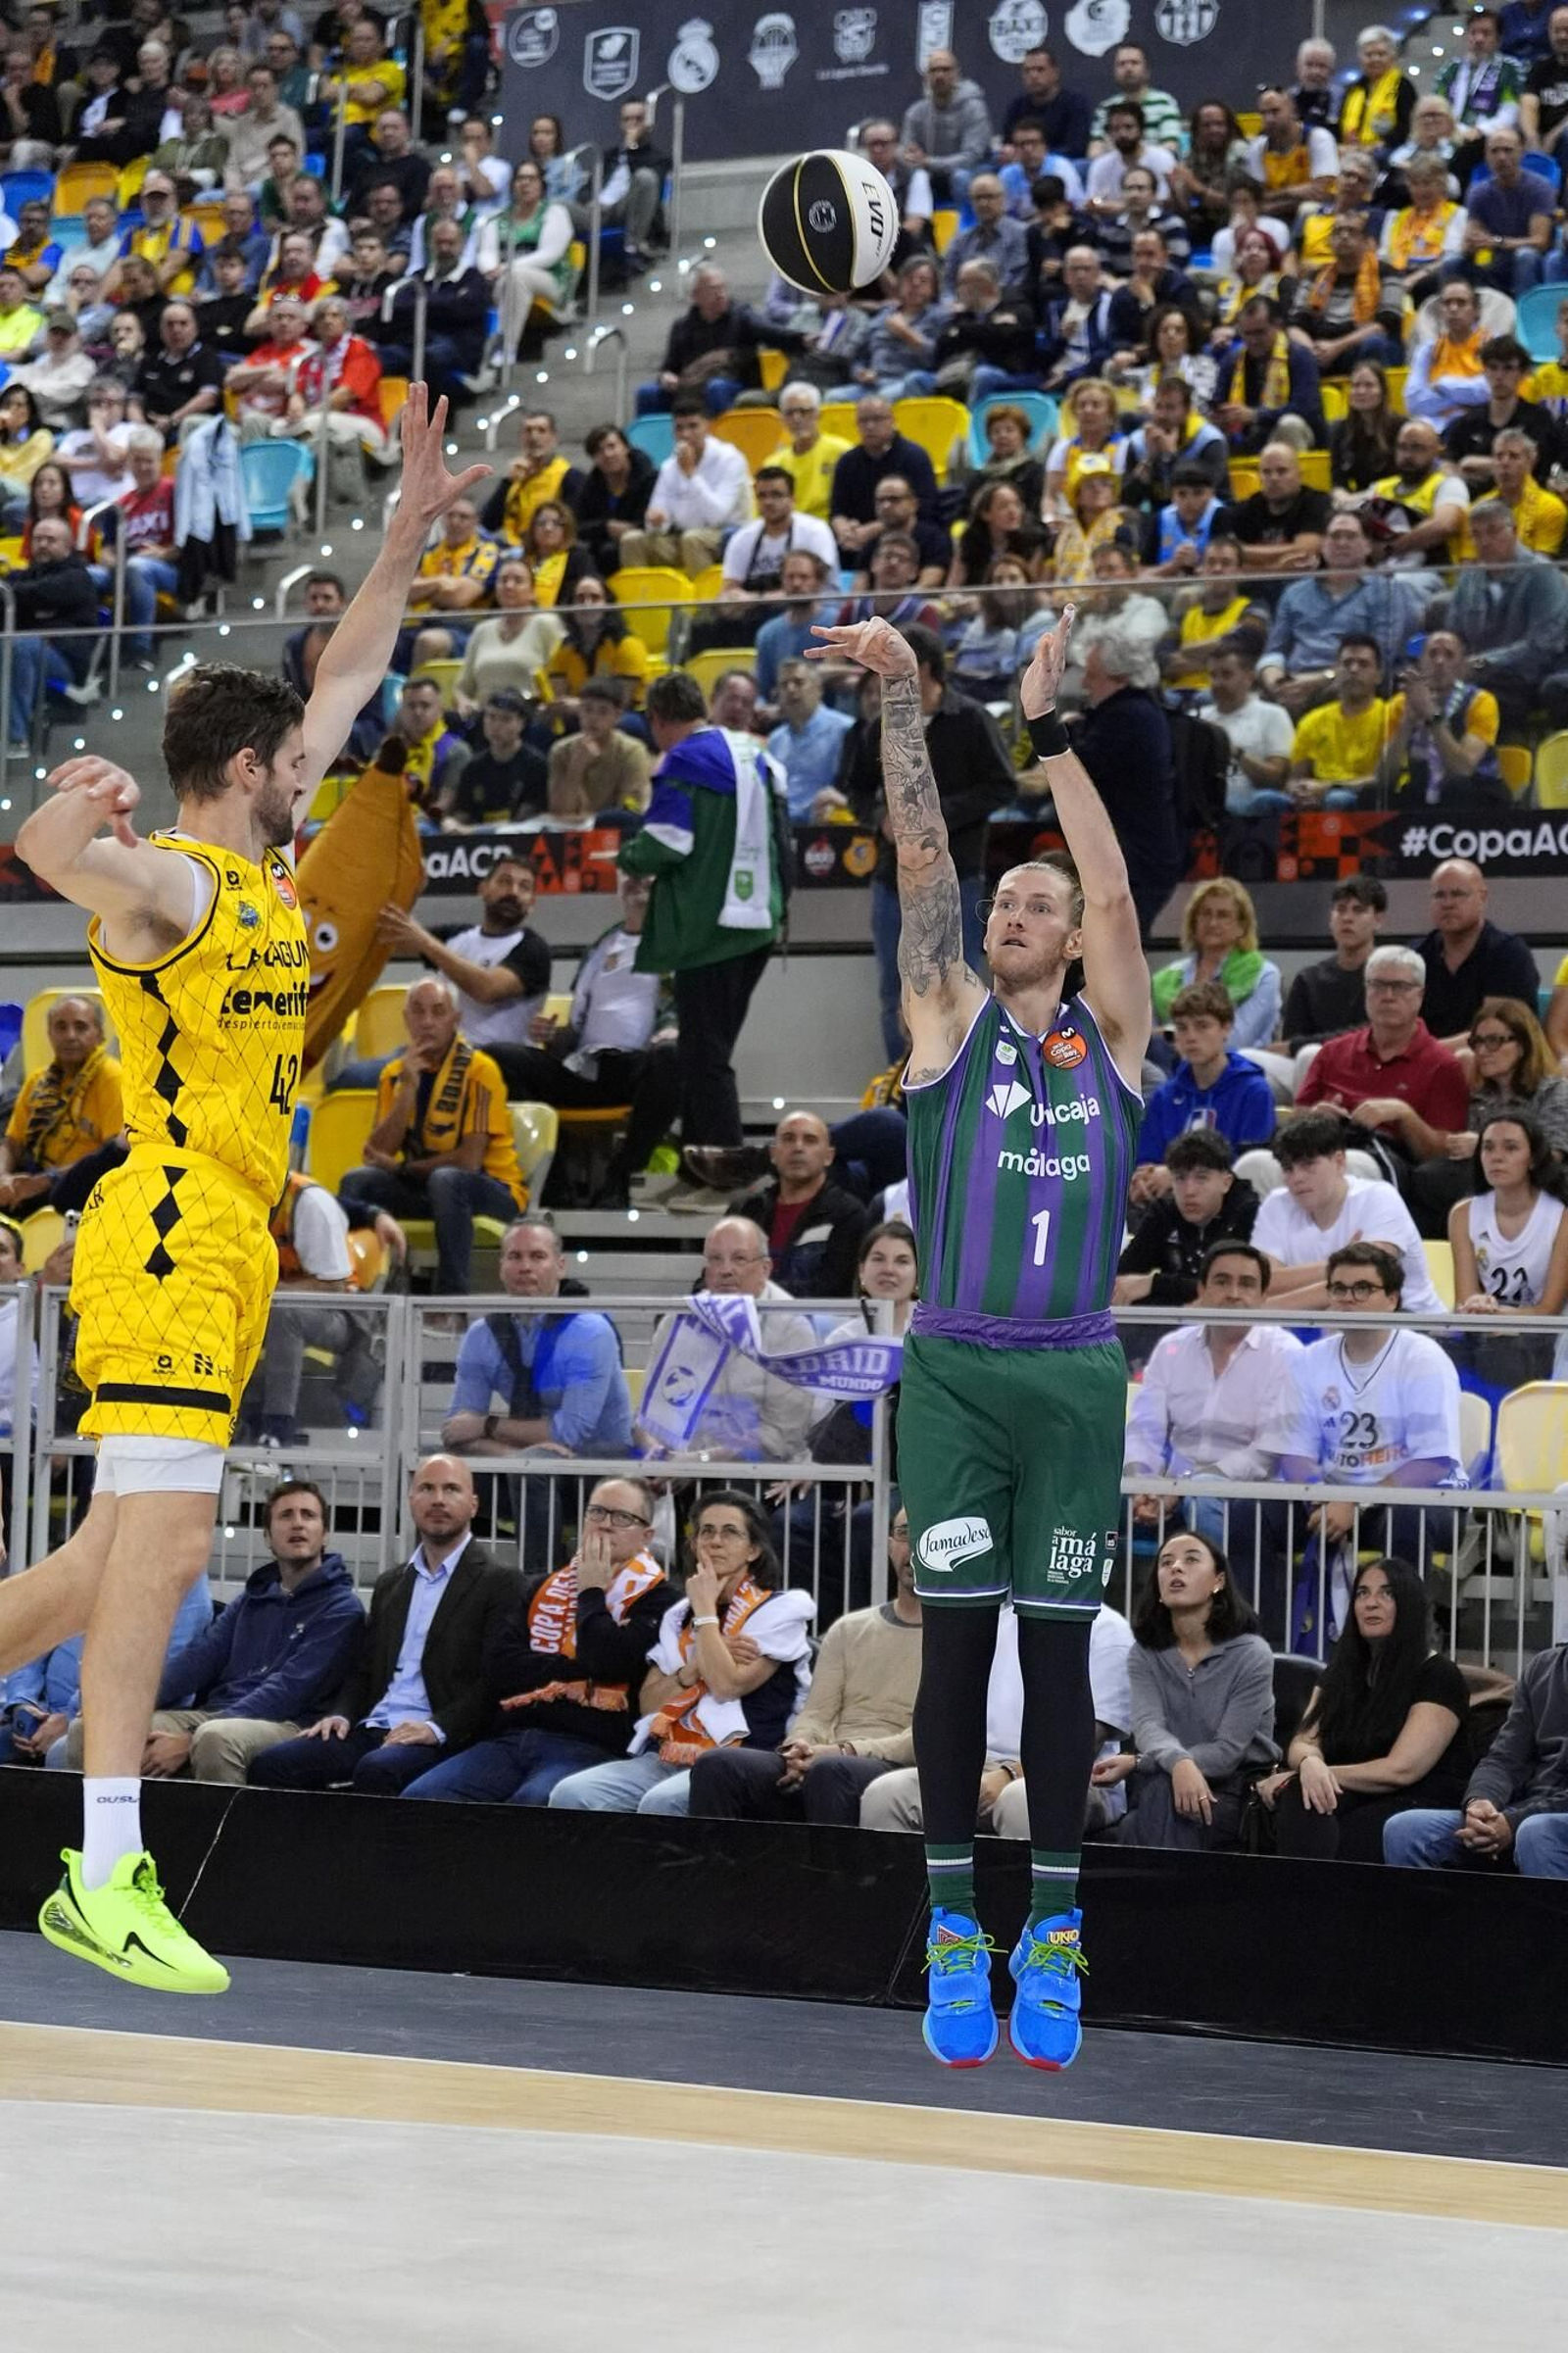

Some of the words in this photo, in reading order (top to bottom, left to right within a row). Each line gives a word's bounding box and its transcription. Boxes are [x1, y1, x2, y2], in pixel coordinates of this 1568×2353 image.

[861, 181, 884, 239] EVO
[264, 940, 311, 968] LAGUN
[220, 981, 309, 1017] tenerif
[270, 1054, 298, 1115] 42
[1032, 1209, 1050, 1266] 1
[770, 1347, 890, 1375] ADRID
[818, 1375, 885, 1392] MUNDO
[1340, 1411, 1379, 1449] 23
[1052, 1536, 1058, 1544] a
[1054, 1525, 1077, 1537] sabor
[530, 1602, 566, 1654] COPA
[1047, 1931, 1079, 1945] UNO
